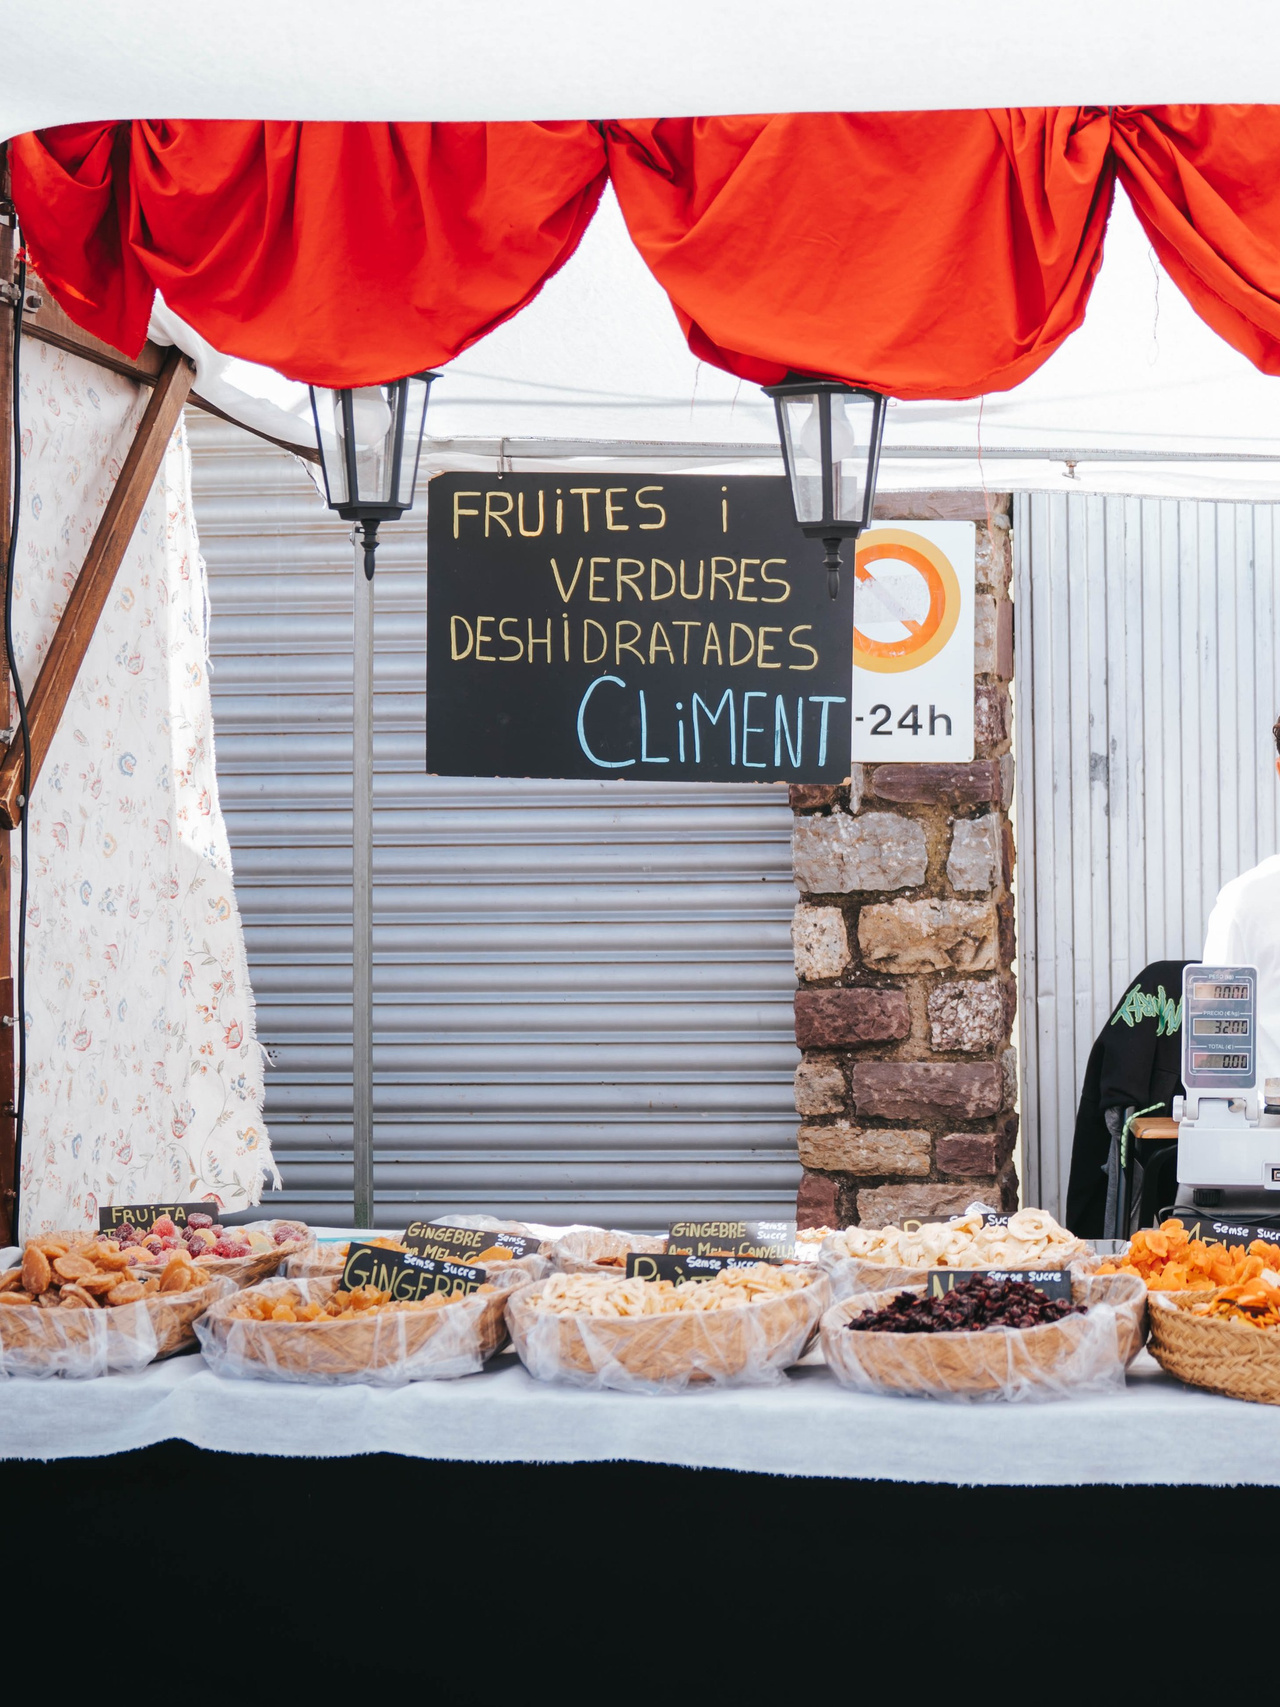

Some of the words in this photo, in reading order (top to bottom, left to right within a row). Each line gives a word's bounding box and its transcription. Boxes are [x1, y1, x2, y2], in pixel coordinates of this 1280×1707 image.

[721, 486, 728, 533] i
[550, 556, 791, 602] VERDURES
[756, 1230, 787, 1241] Sucre
[442, 1262, 476, 1279] Sucre
[1028, 1271, 1062, 1283] Sucre
